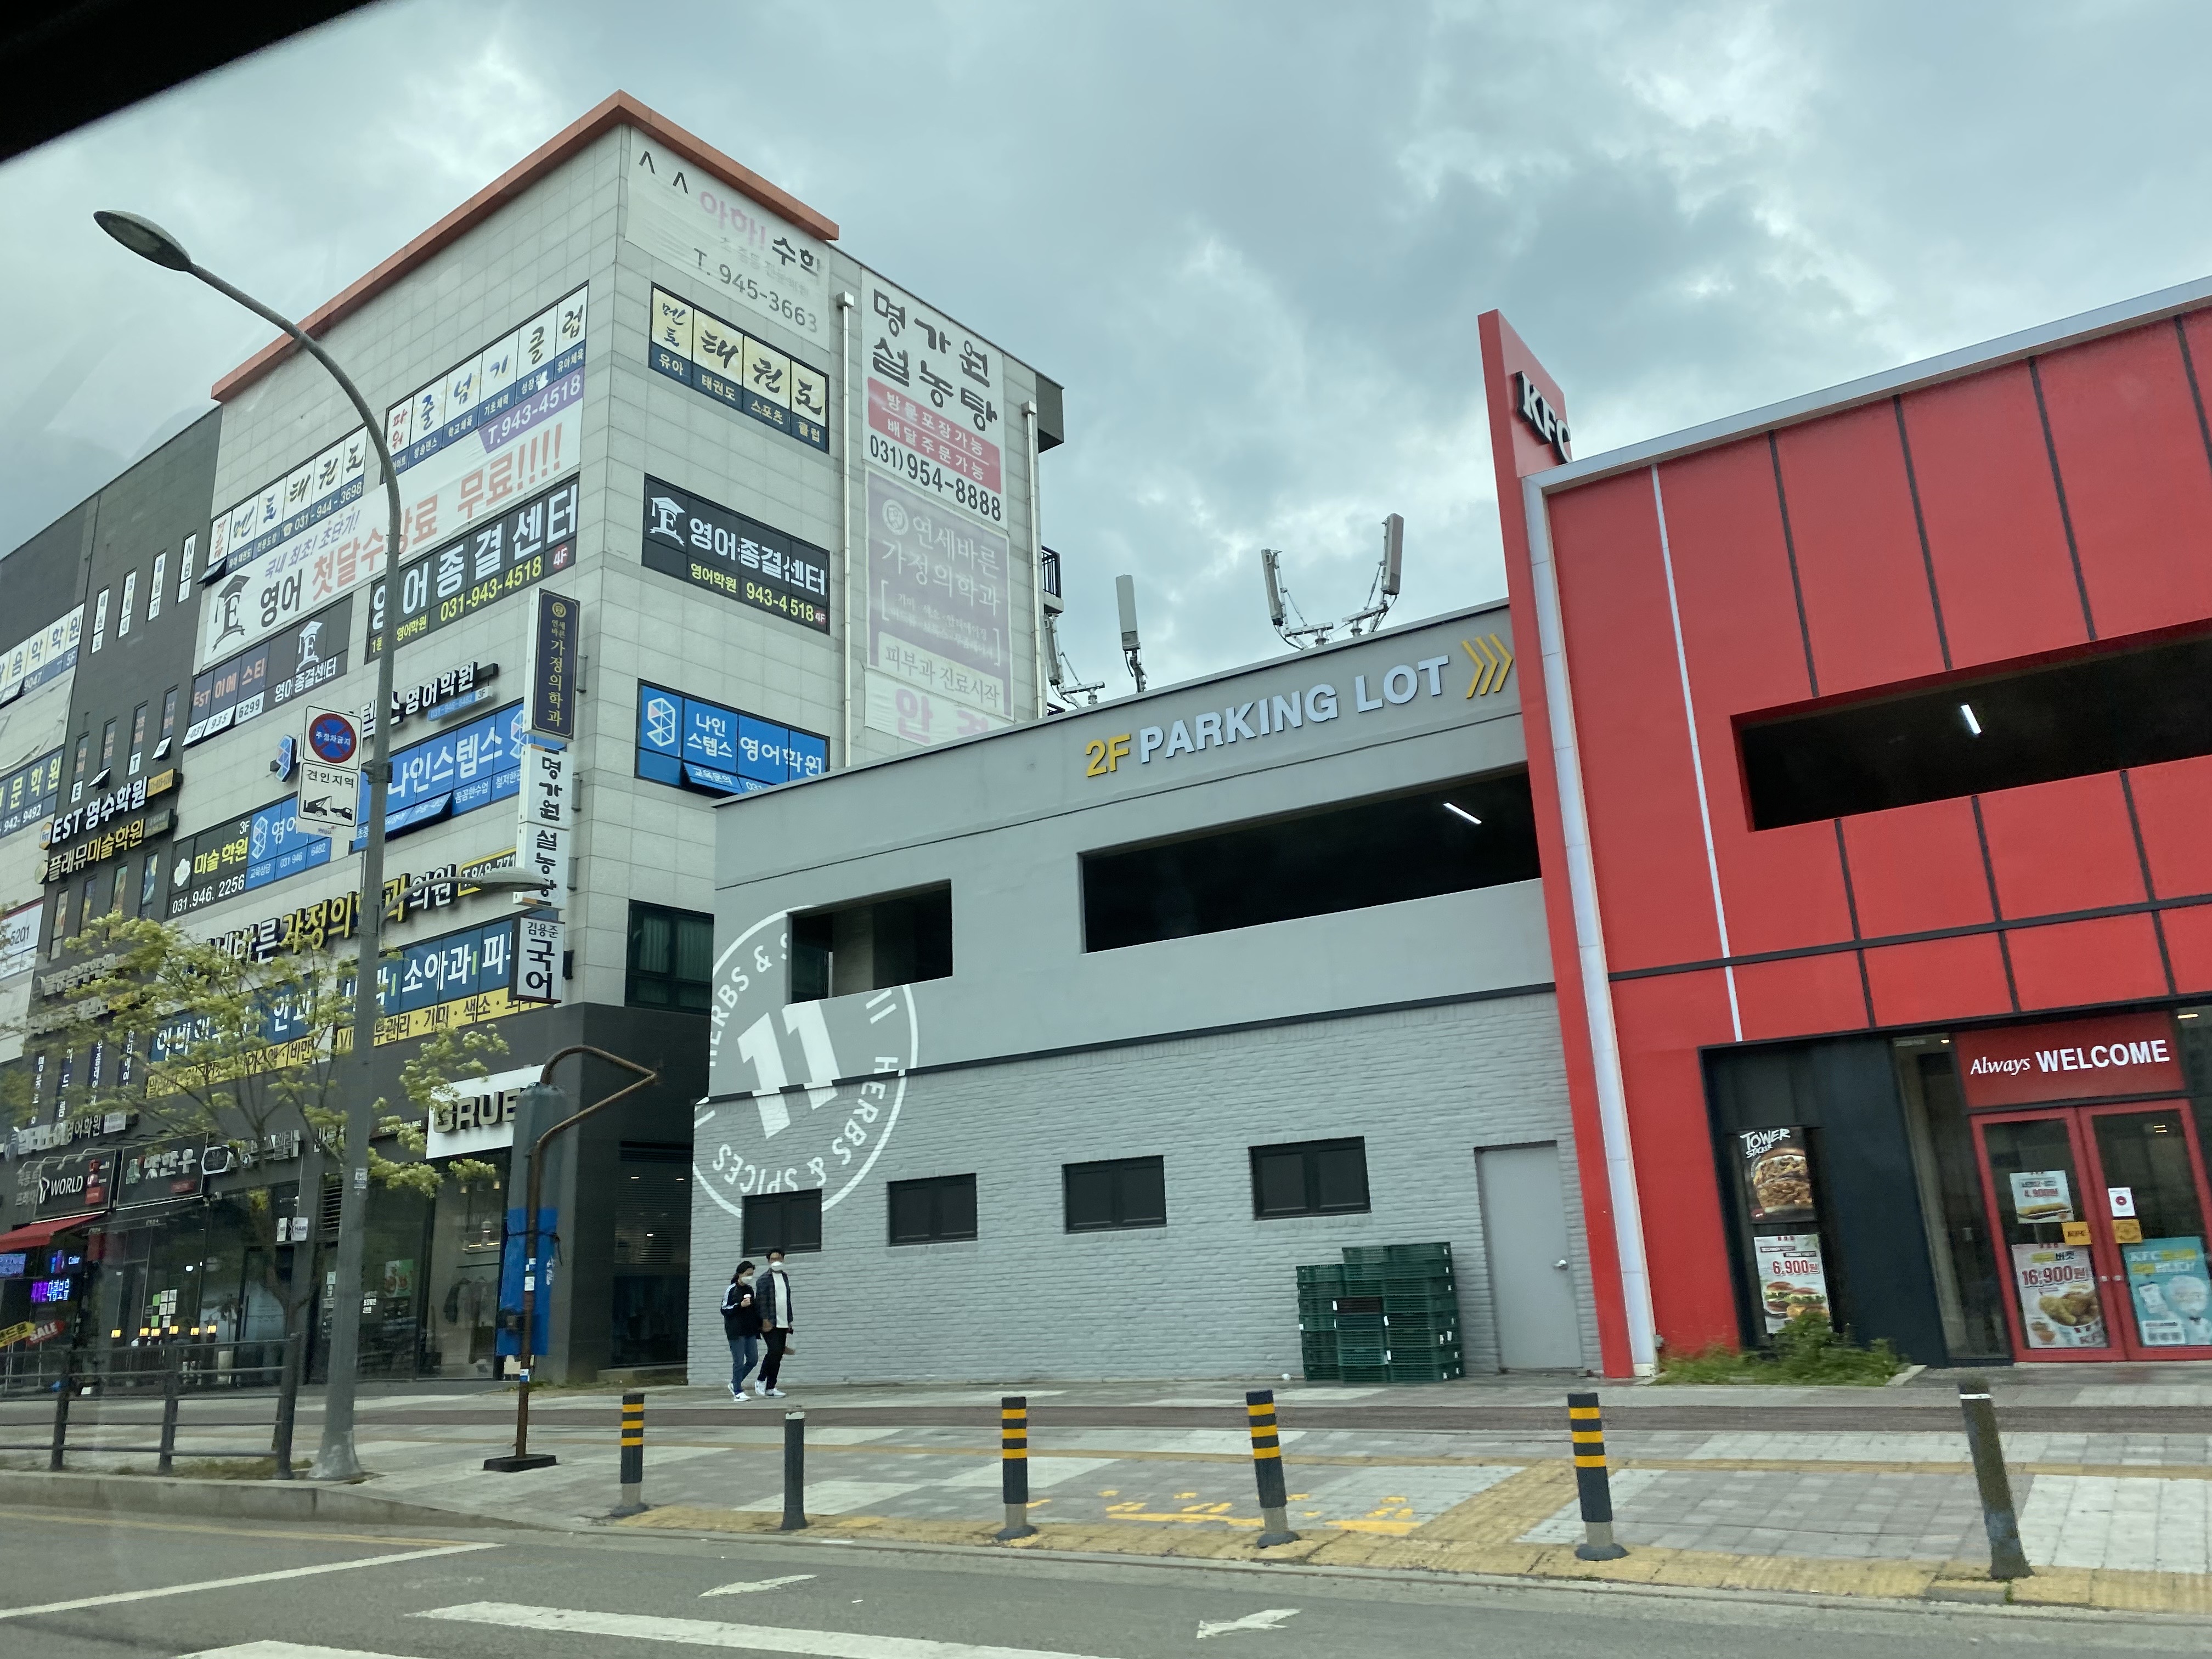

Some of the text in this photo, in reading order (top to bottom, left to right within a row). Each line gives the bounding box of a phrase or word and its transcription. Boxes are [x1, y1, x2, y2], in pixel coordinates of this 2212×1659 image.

[719, 263, 817, 332] 945-3663
[873, 288, 990, 387] 명가원
[659, 353, 821, 443] 유아 태권도 스포츠 클럽
[700, 330, 822, 415] 태권도
[872, 336, 998, 432] 설농탕
[392, 455, 407, 472] 이어트
[484, 392, 509, 416] 기초체력
[557, 348, 584, 374] 유아체육
[1516, 371, 1573, 464] KFC
[870, 435, 1002, 522] 031)954-8888
[265, 551, 287, 579] 국내
[288, 535, 318, 567] 최초!
[689, 517, 826, 596] 영어종결센터
[881, 539, 1000, 616] 가정의학과
[912, 515, 1000, 579] 연세바른
[260, 569, 303, 628] 영어
[397, 546, 568, 641] 영어학원 031-943-4518 4F
[690, 563, 737, 594] 영어학원
[746, 582, 814, 622] 943-4518
[275, 656, 337, 703] 영어종결센터
[405, 664, 474, 715] 영어학원
[547, 639, 566, 727] 가정의학과
[884, 645, 935, 685] 피부과
[193, 689, 211, 708] EST
[696, 713, 726, 737] 나인
[1085, 654, 1449, 778] 2F PARKING LOT
[315, 731, 351, 746] 주정차금지
[387, 726, 503, 798] 나인스텝스
[686, 732, 822, 777] 스텝스 영어학원
[306, 769, 354, 788] 견인지역
[539, 756, 563, 821] 명가원
[52, 808, 83, 844] EST
[86, 775, 148, 831] 영수학원
[239, 820, 250, 834] 3F
[194, 837, 249, 874] 미술학원
[527, 921, 558, 938] 김용준
[402, 944, 471, 994] 소아과
[526, 938, 555, 999] 국어
[464, 995, 491, 1023] 색소
[737, 999, 842, 1139] 11
[1970, 1039, 2171, 1076] Always WELCOME
[831, 1057, 899, 1165] HERBS
[1739, 1127, 1791, 1150] TOWER
[50, 1175, 83, 1197] WORLD
